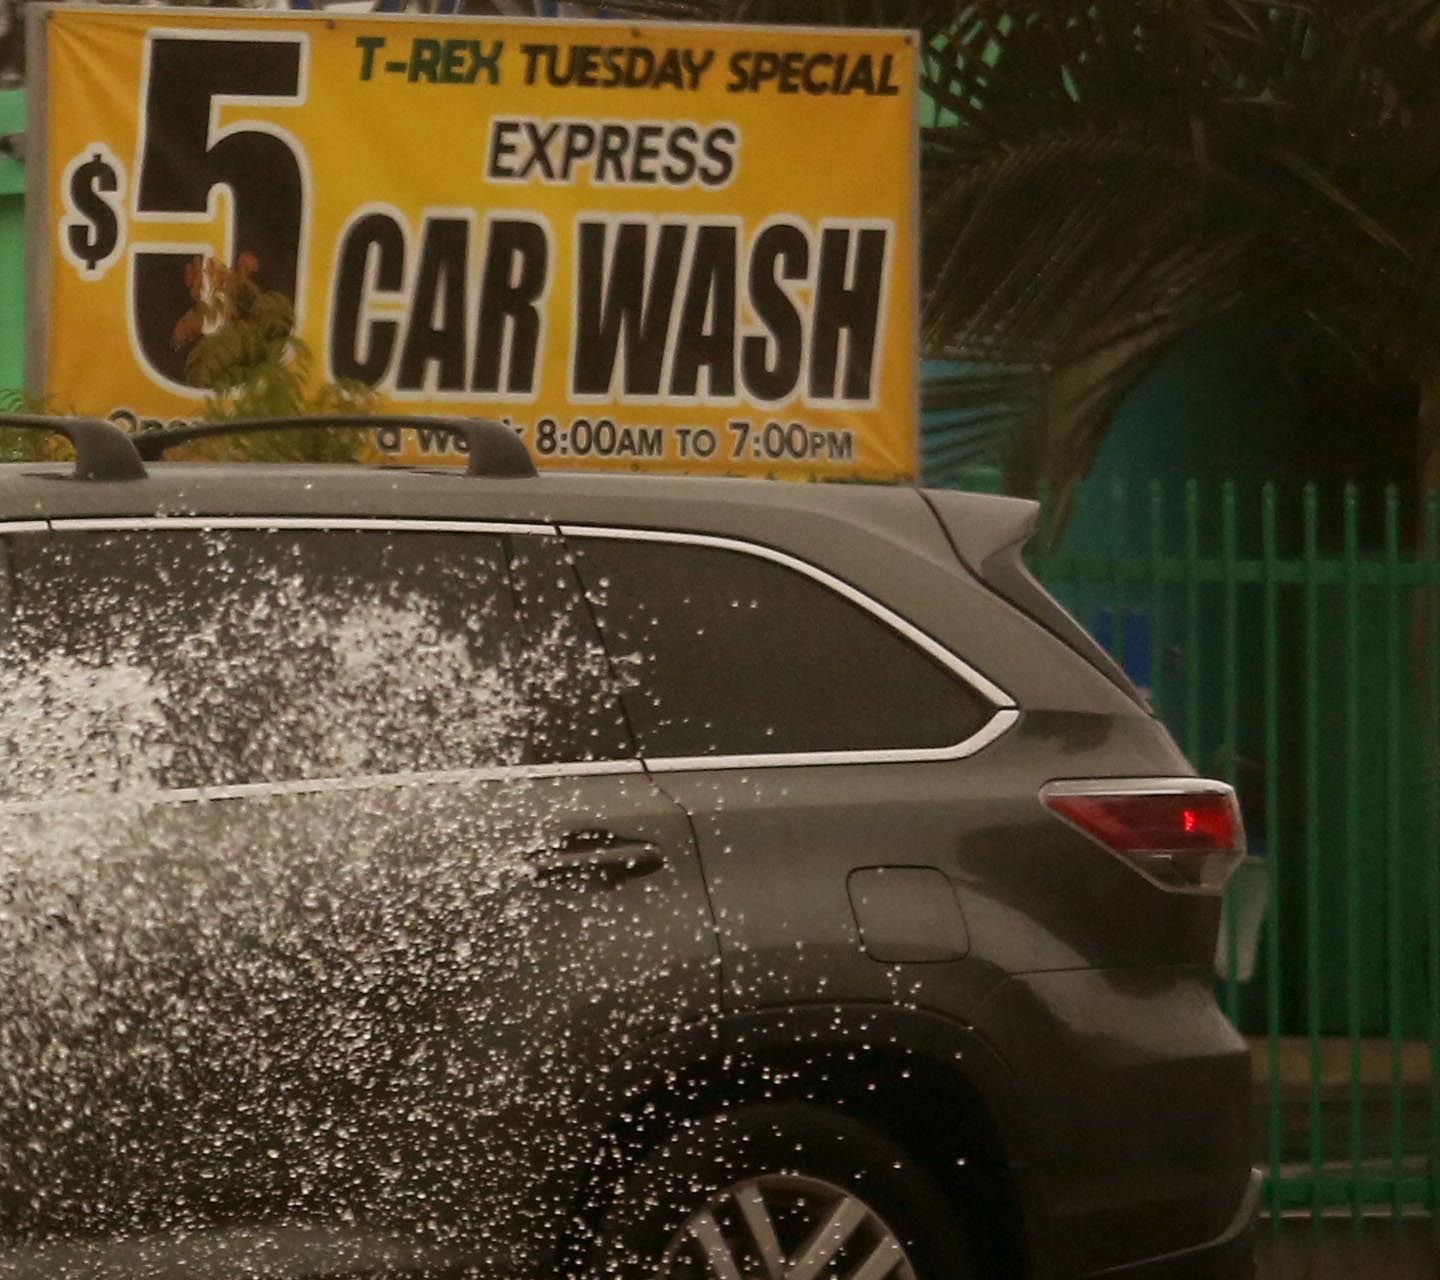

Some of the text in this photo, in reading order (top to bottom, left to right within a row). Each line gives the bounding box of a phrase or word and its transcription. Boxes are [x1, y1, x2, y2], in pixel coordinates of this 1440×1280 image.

[357, 36, 899, 96] T-REX TUESDAY SPECIAL
[490, 122, 735, 185] EXPRESS
[331, 213, 886, 401] CAR WASH
[536, 419, 663, 456] 8:00AM
[677, 429, 716, 457] TO
[730, 422, 853, 458] 7:00PM
